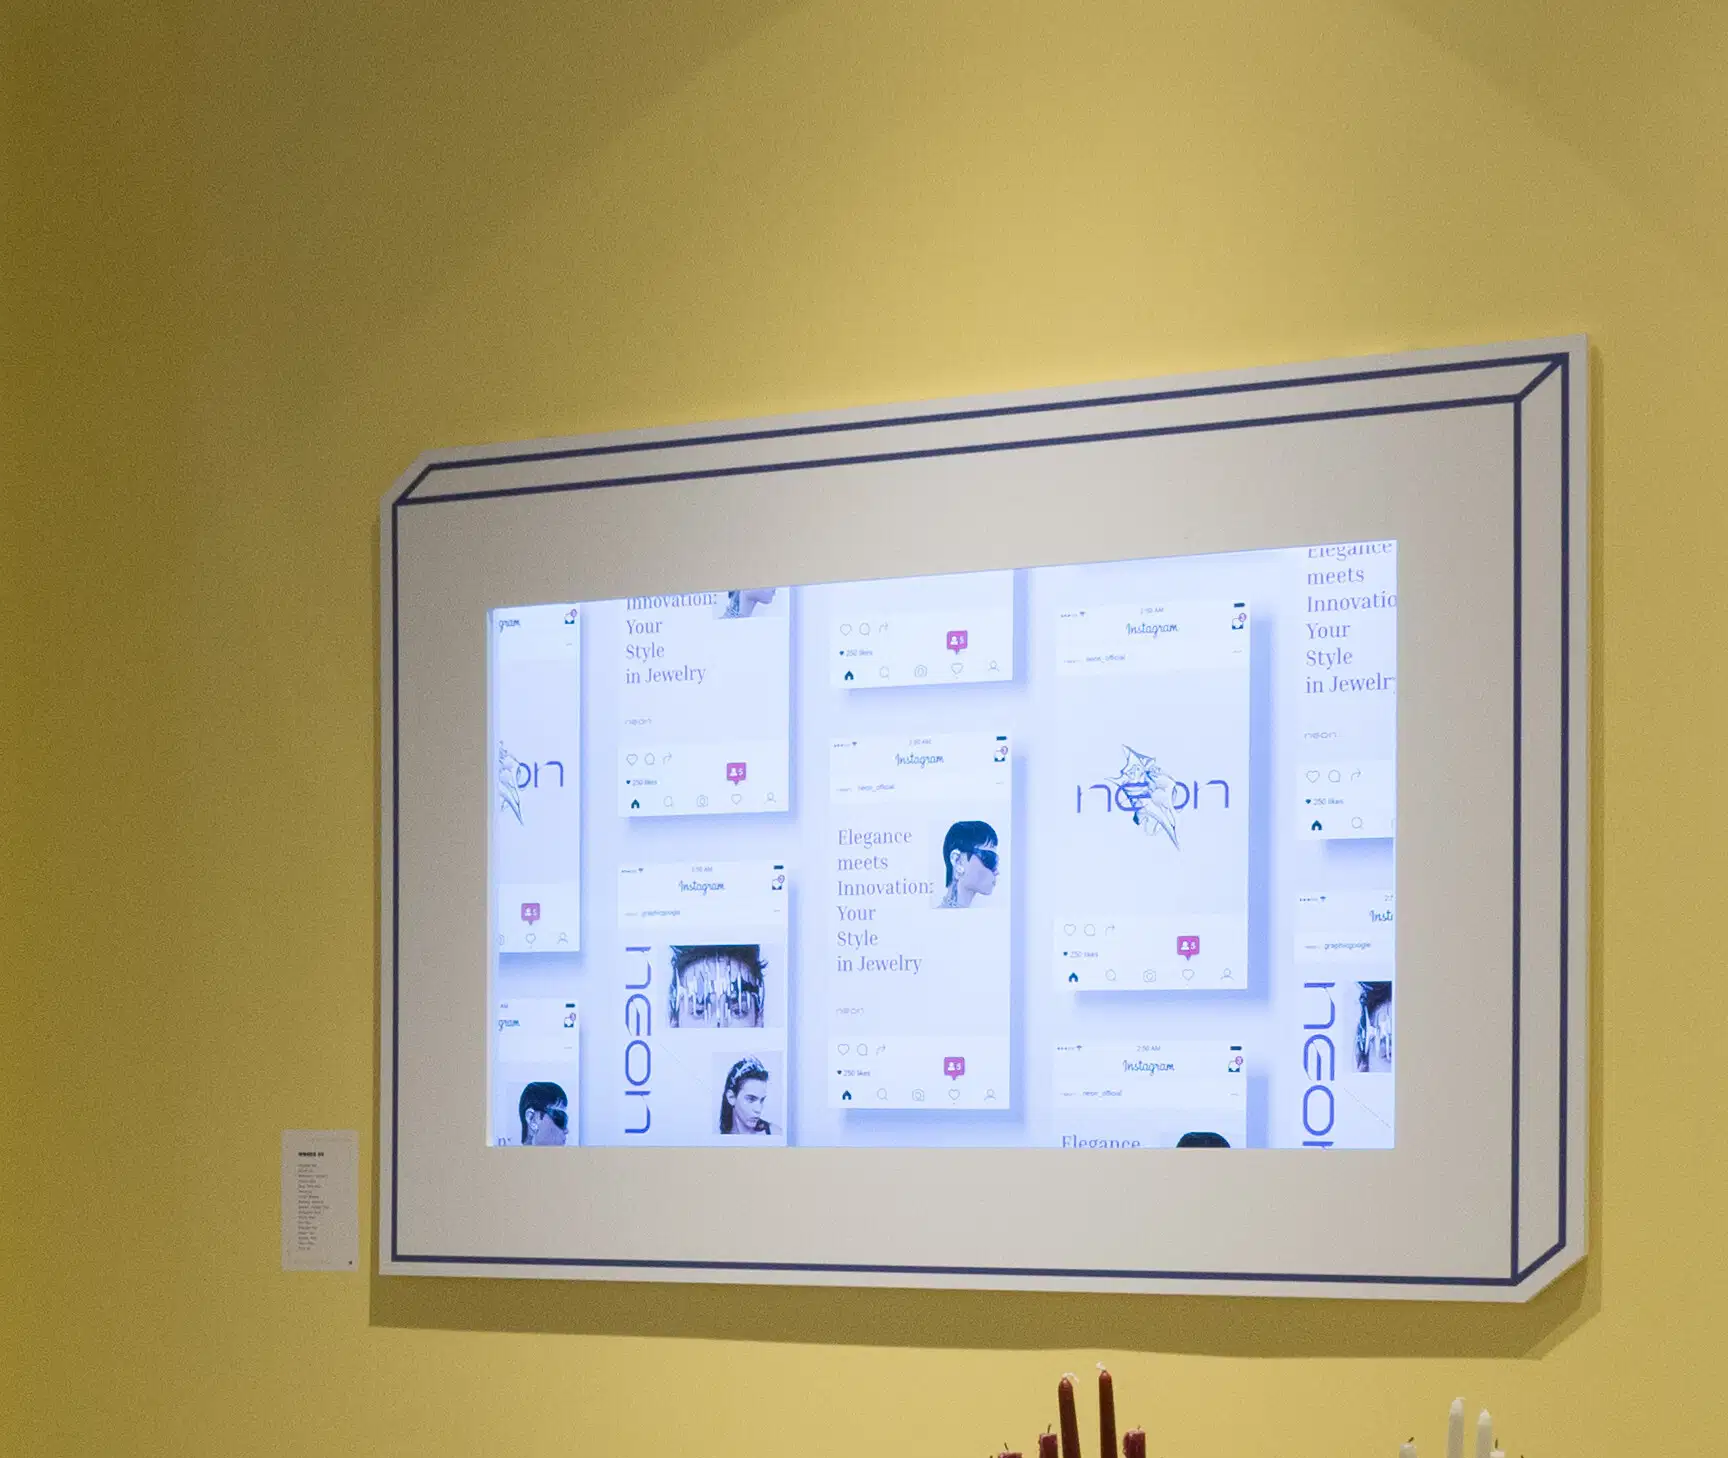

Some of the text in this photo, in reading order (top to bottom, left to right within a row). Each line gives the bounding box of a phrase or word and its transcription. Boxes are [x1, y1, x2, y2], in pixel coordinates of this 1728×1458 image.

[1307, 568, 1365, 586] meets
[625, 619, 663, 636] Your
[1125, 622, 1180, 638] Instagram
[1306, 622, 1351, 640] Your
[625, 641, 665, 663] Style
[1306, 647, 1353, 670] Style
[625, 664, 707, 685] in Jewelry
[1306, 676, 1324, 694] in
[895, 753, 945, 768] Instagram
[837, 829, 913, 849] Elegance
[836, 855, 889, 871] meets
[678, 879, 725, 897] Instagram
[836, 878, 935, 896] Innovation:
[836, 905, 876, 922] Your
[836, 929, 879, 948] Style
[836, 954, 923, 975] in Jewelry
[1122, 1059, 1175, 1077] Instagram
[1303, 982, 1336, 1149] neo
[1061, 1135, 1141, 1149] Elegance
